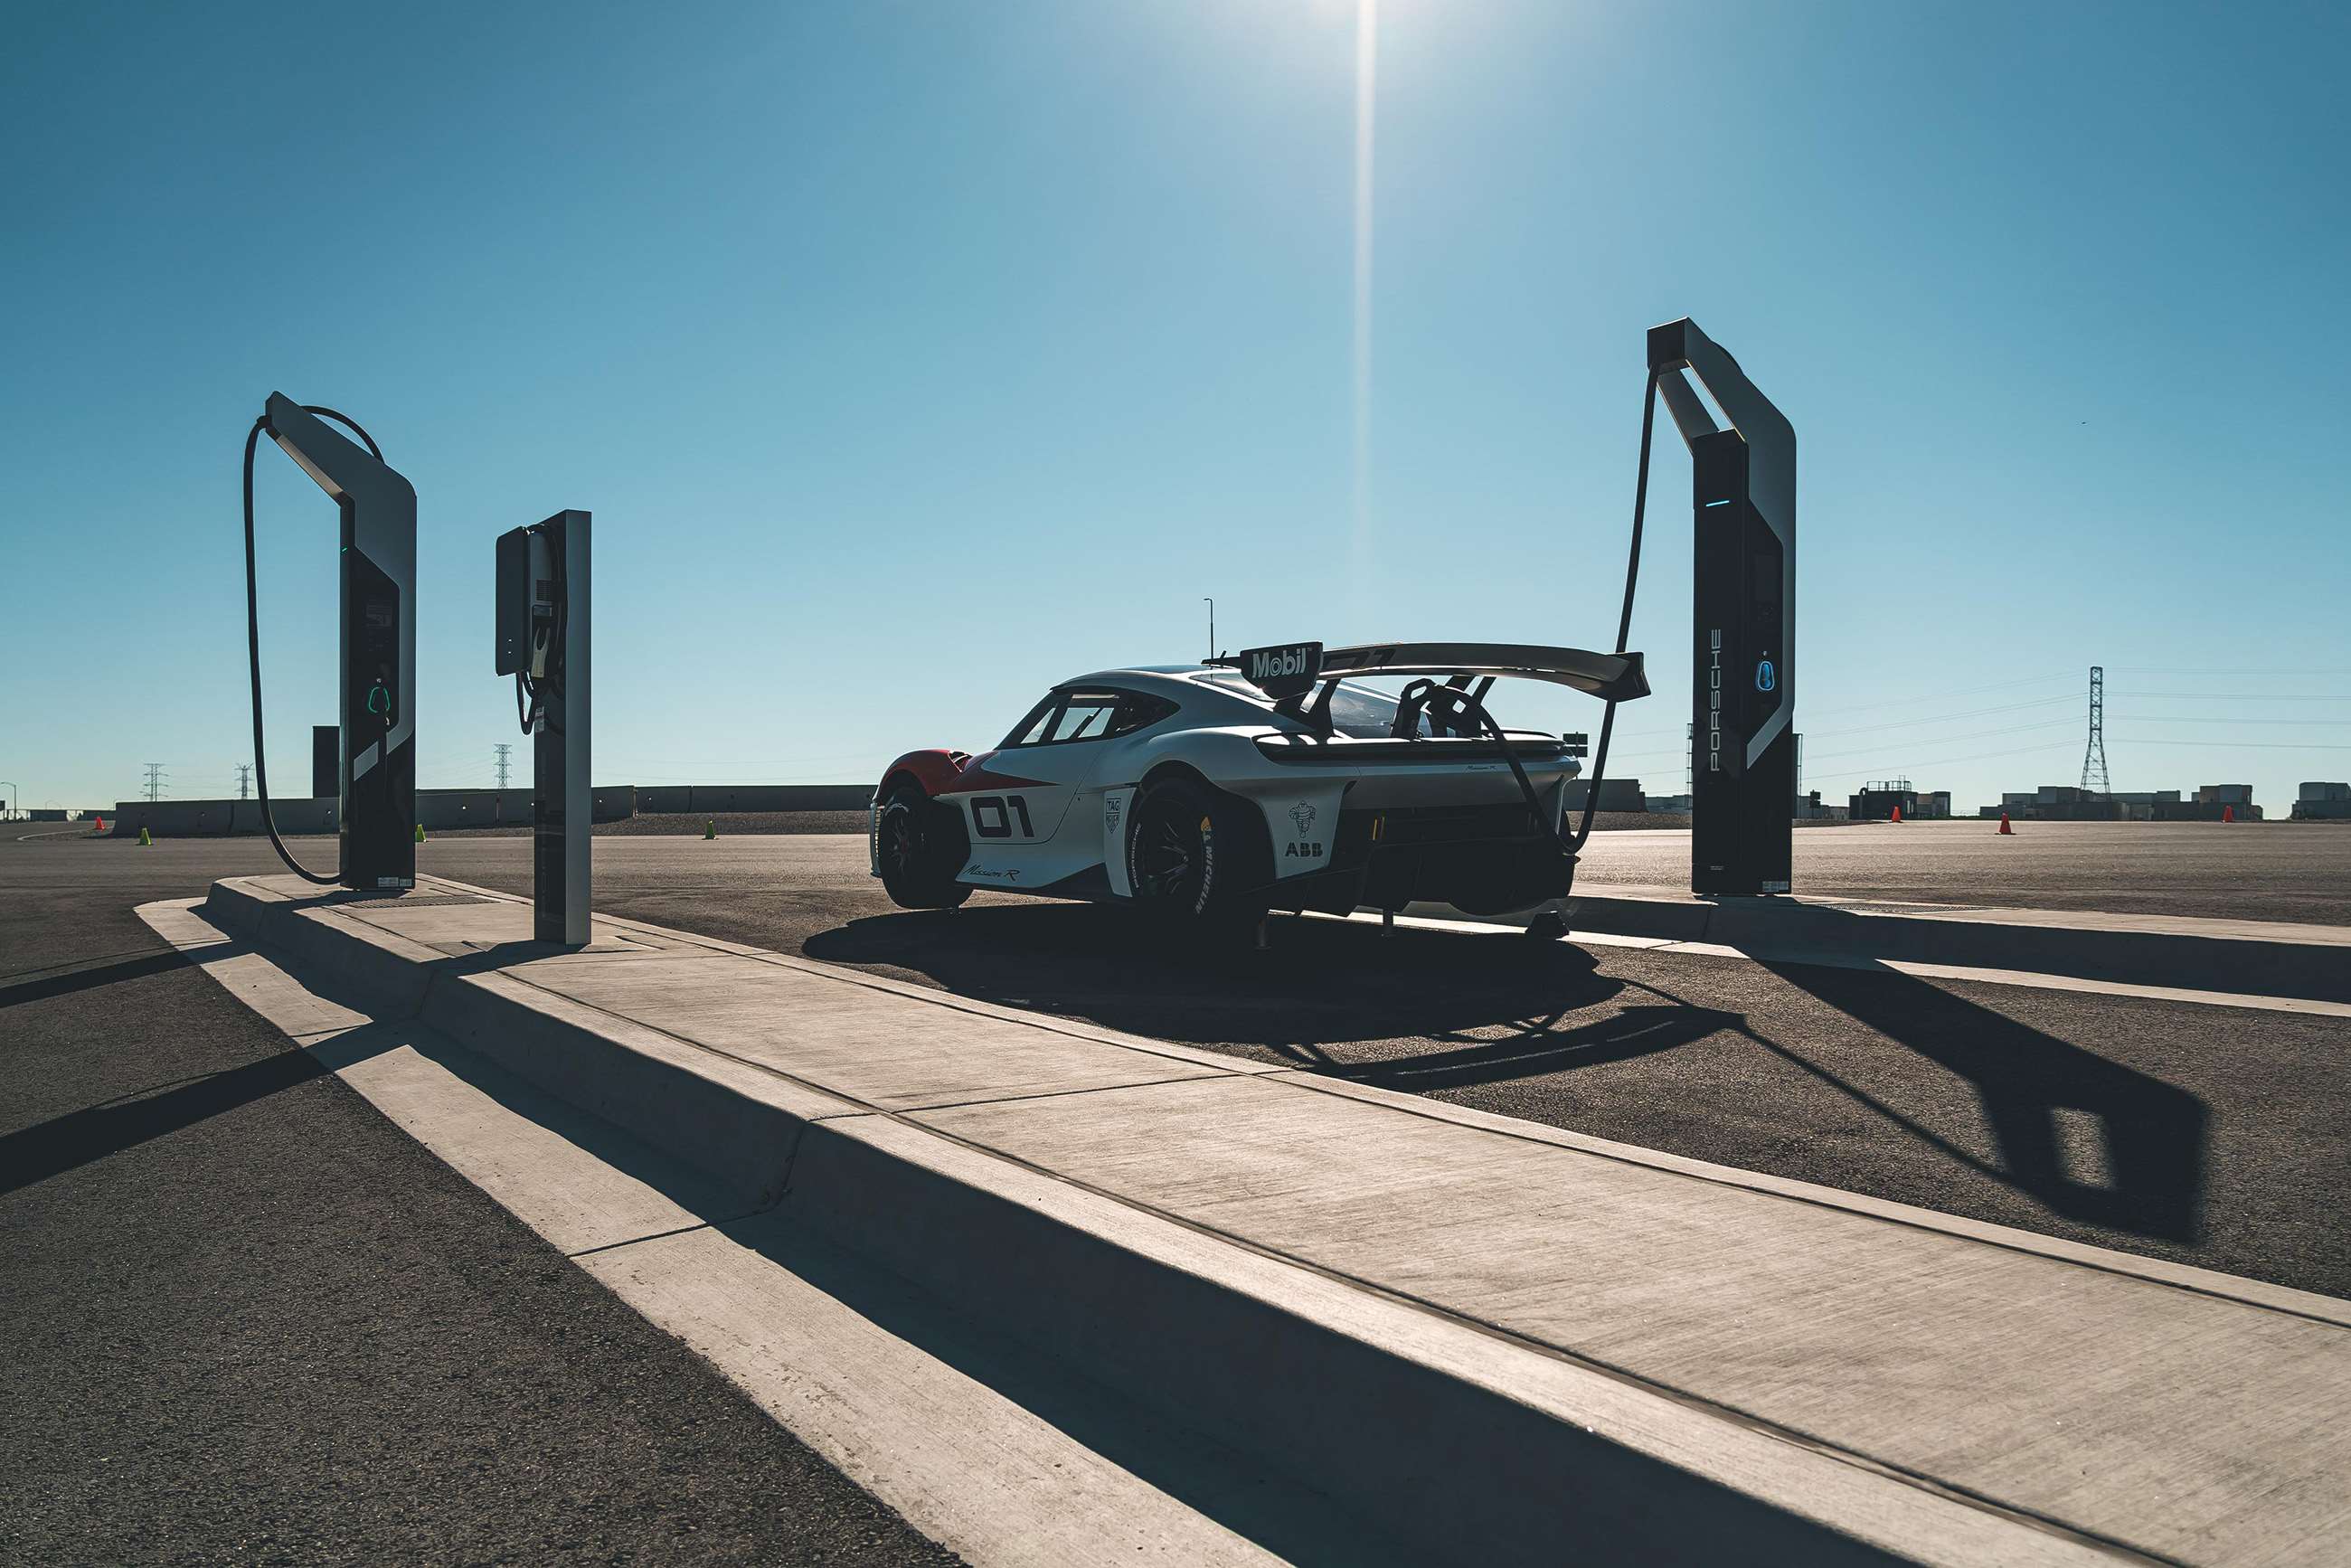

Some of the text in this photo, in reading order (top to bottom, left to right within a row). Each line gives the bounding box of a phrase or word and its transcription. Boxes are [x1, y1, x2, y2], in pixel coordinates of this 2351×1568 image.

[1251, 647, 1307, 679] Mobil
[1710, 628, 1722, 772] PORSCHE
[970, 795, 1035, 838] 01
[1107, 799, 1121, 811] TAG
[1285, 842, 1324, 857] ABB
[1004, 869, 1021, 882] R
[1194, 845, 1214, 914] MICHELIN
